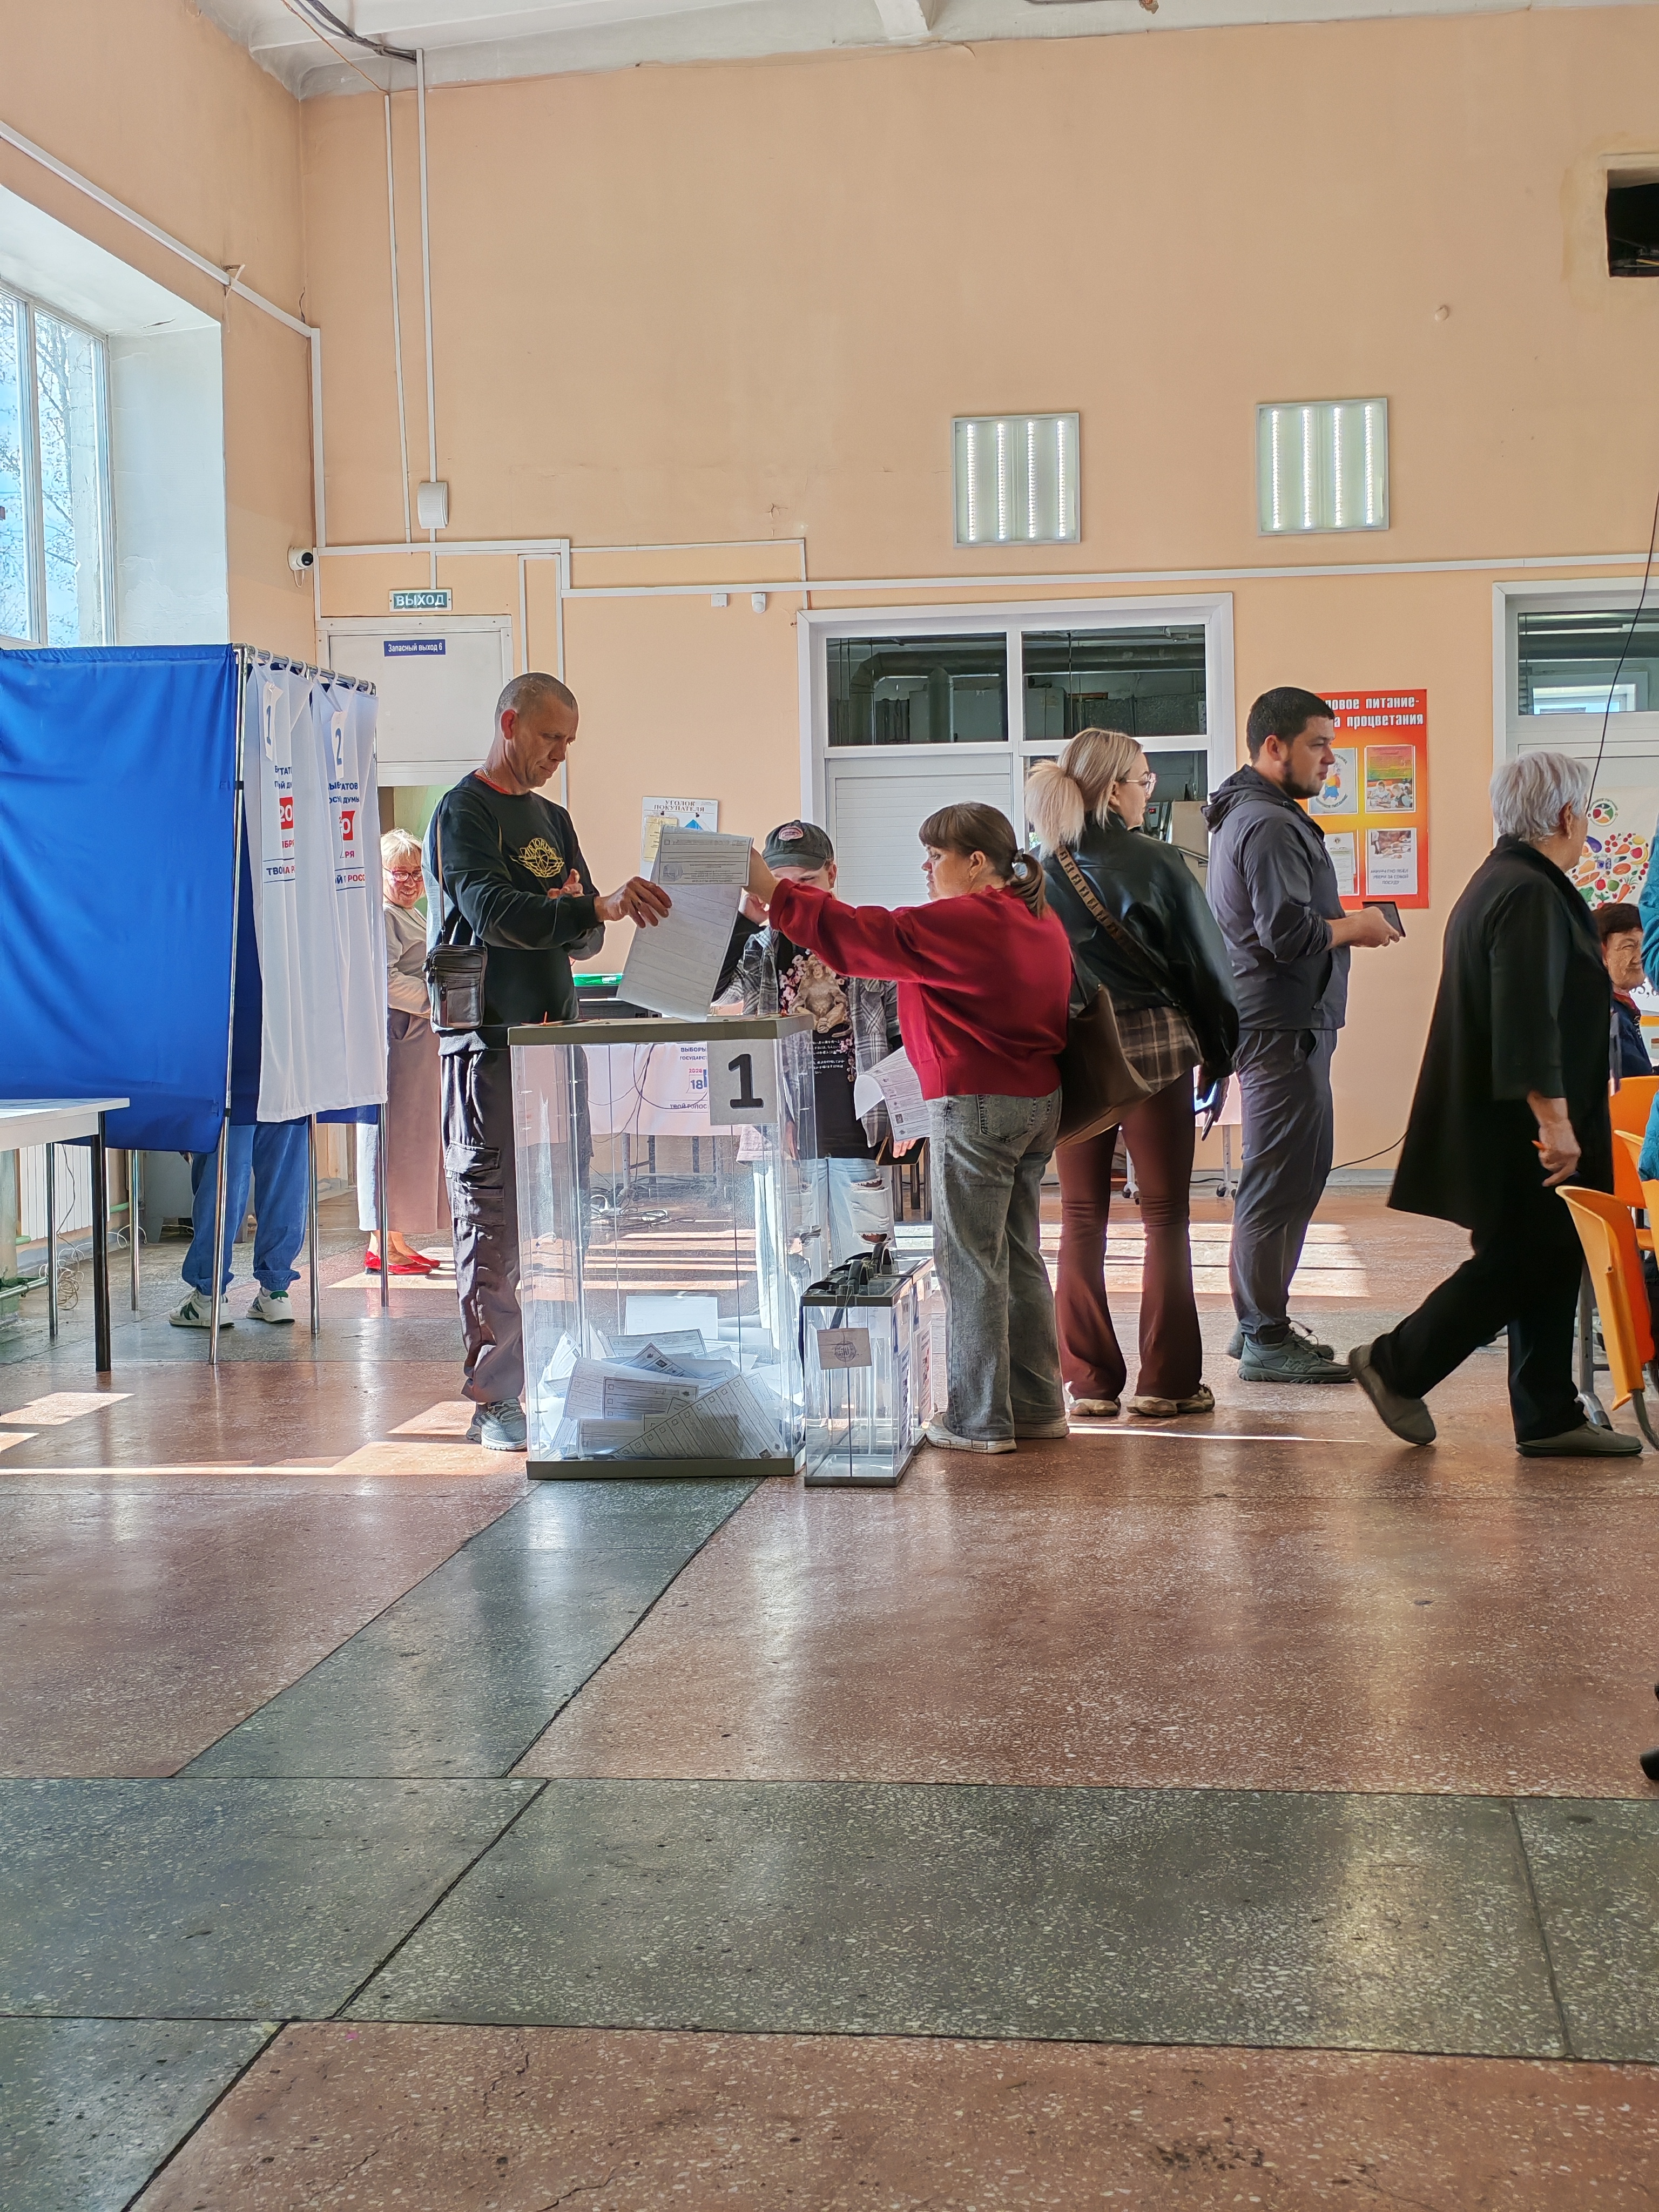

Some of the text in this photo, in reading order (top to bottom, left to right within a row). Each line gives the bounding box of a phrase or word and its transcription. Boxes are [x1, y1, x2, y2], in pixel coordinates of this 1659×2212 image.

[396, 595, 444, 606] ВЫХОД
[388, 643, 417, 652] Запасный
[1366, 697, 1419, 709] питание-
[1347, 714, 1423, 730] процветания
[335, 728, 342, 765] 2
[690, 1080, 703, 1089] 18
[729, 1054, 763, 1107] 1
